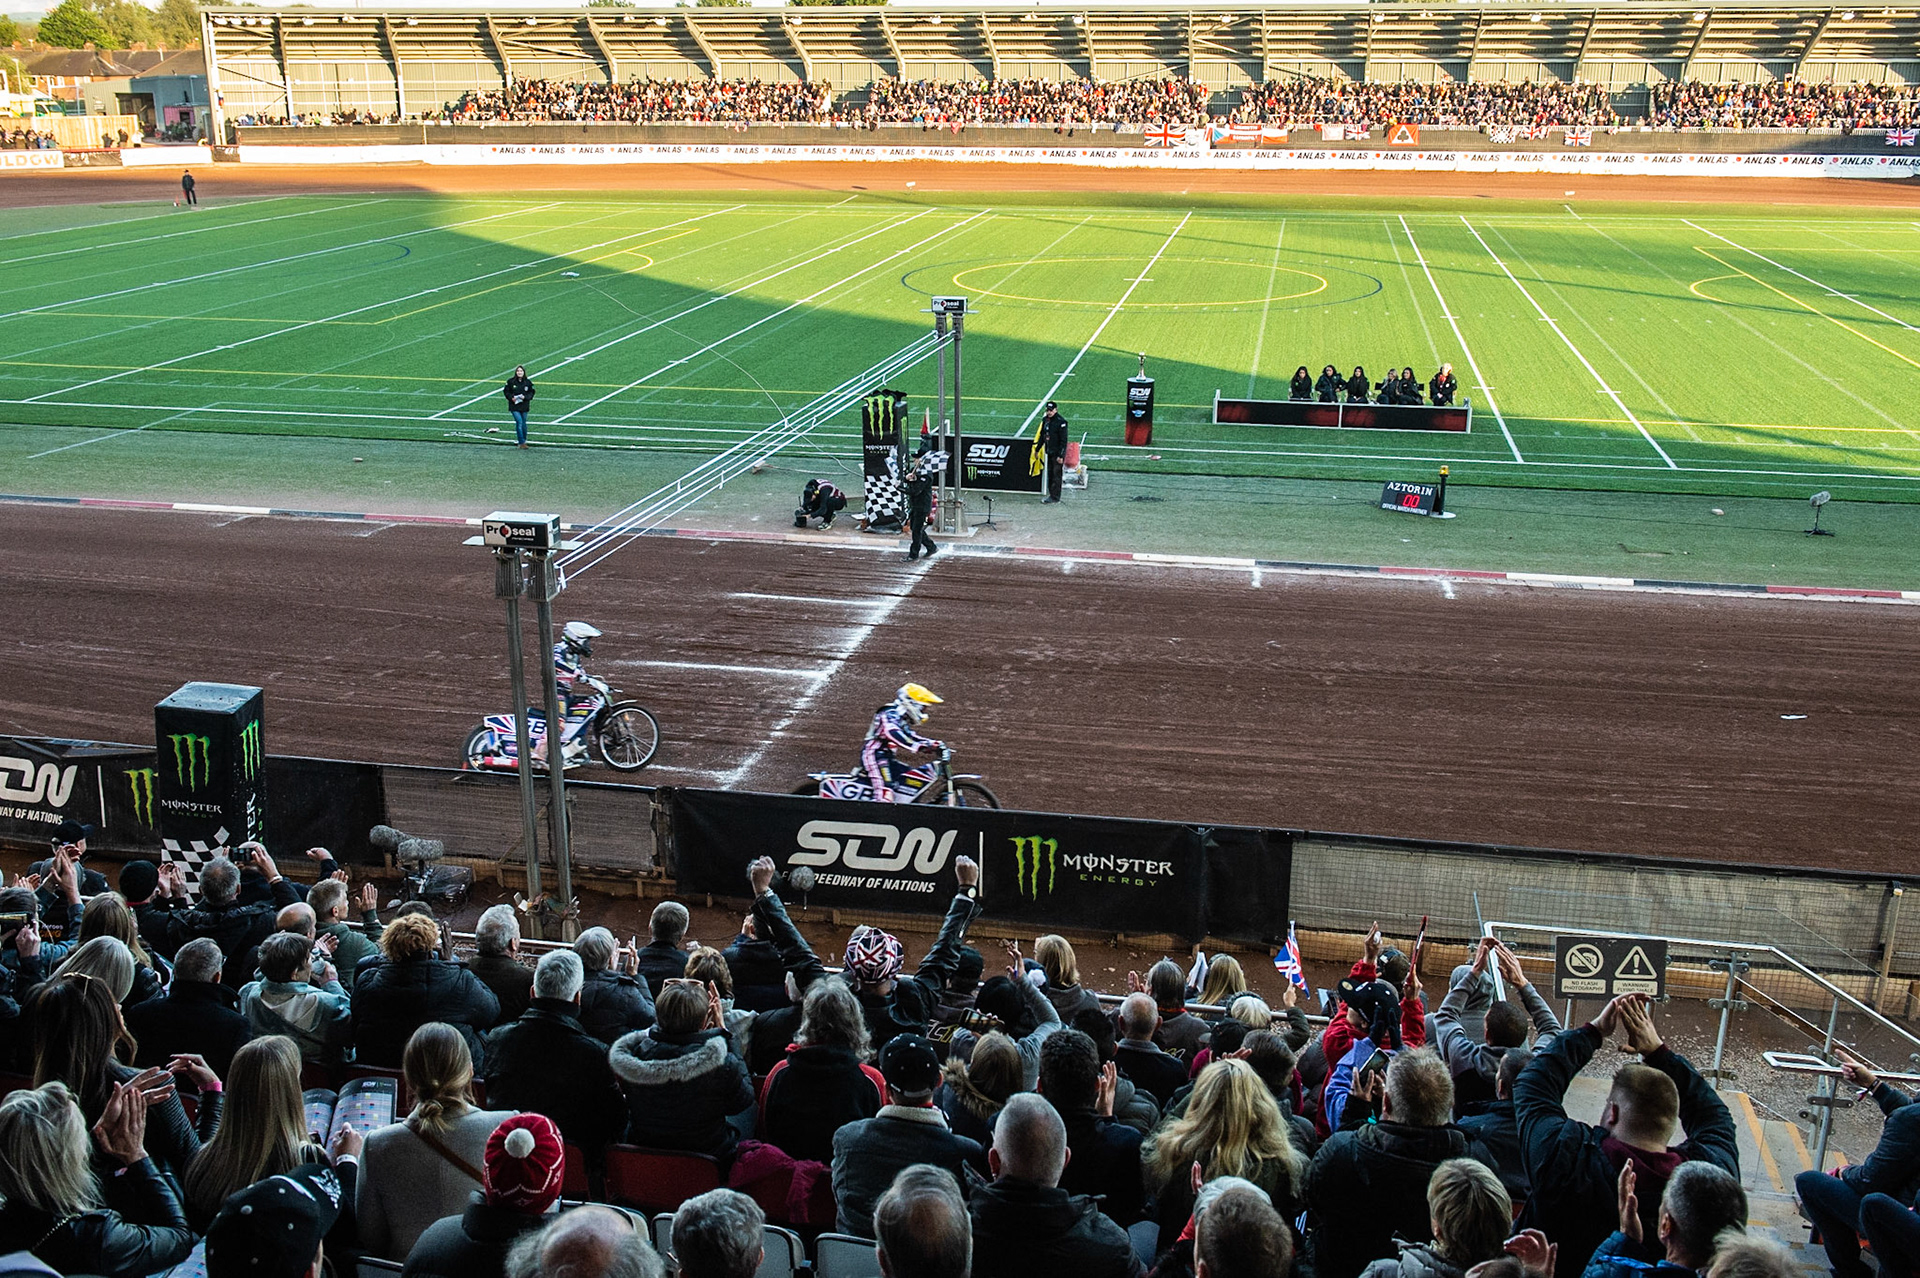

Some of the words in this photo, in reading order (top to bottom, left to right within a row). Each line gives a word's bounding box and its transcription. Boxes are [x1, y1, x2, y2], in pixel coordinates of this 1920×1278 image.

[1744, 156, 1776, 164] ANLAS
[1791, 157, 1824, 165] ANLAS
[1841, 157, 1874, 165] ANLAS
[1889, 158, 1920, 167] ANLAS
[1387, 481, 1433, 496] AZTORIN
[486, 524, 536, 538] Proseal
[161, 799, 223, 814] MONSTER
[14, 808, 27, 819] OF
[27, 810, 63, 825] NATIONS
[787, 820, 958, 875] SDN
[1063, 853, 1174, 876] MONSTER
[865, 877, 883, 889] OF
[882, 879, 936, 893] NATIONS
[1080, 874, 1157, 886] ENERGY
